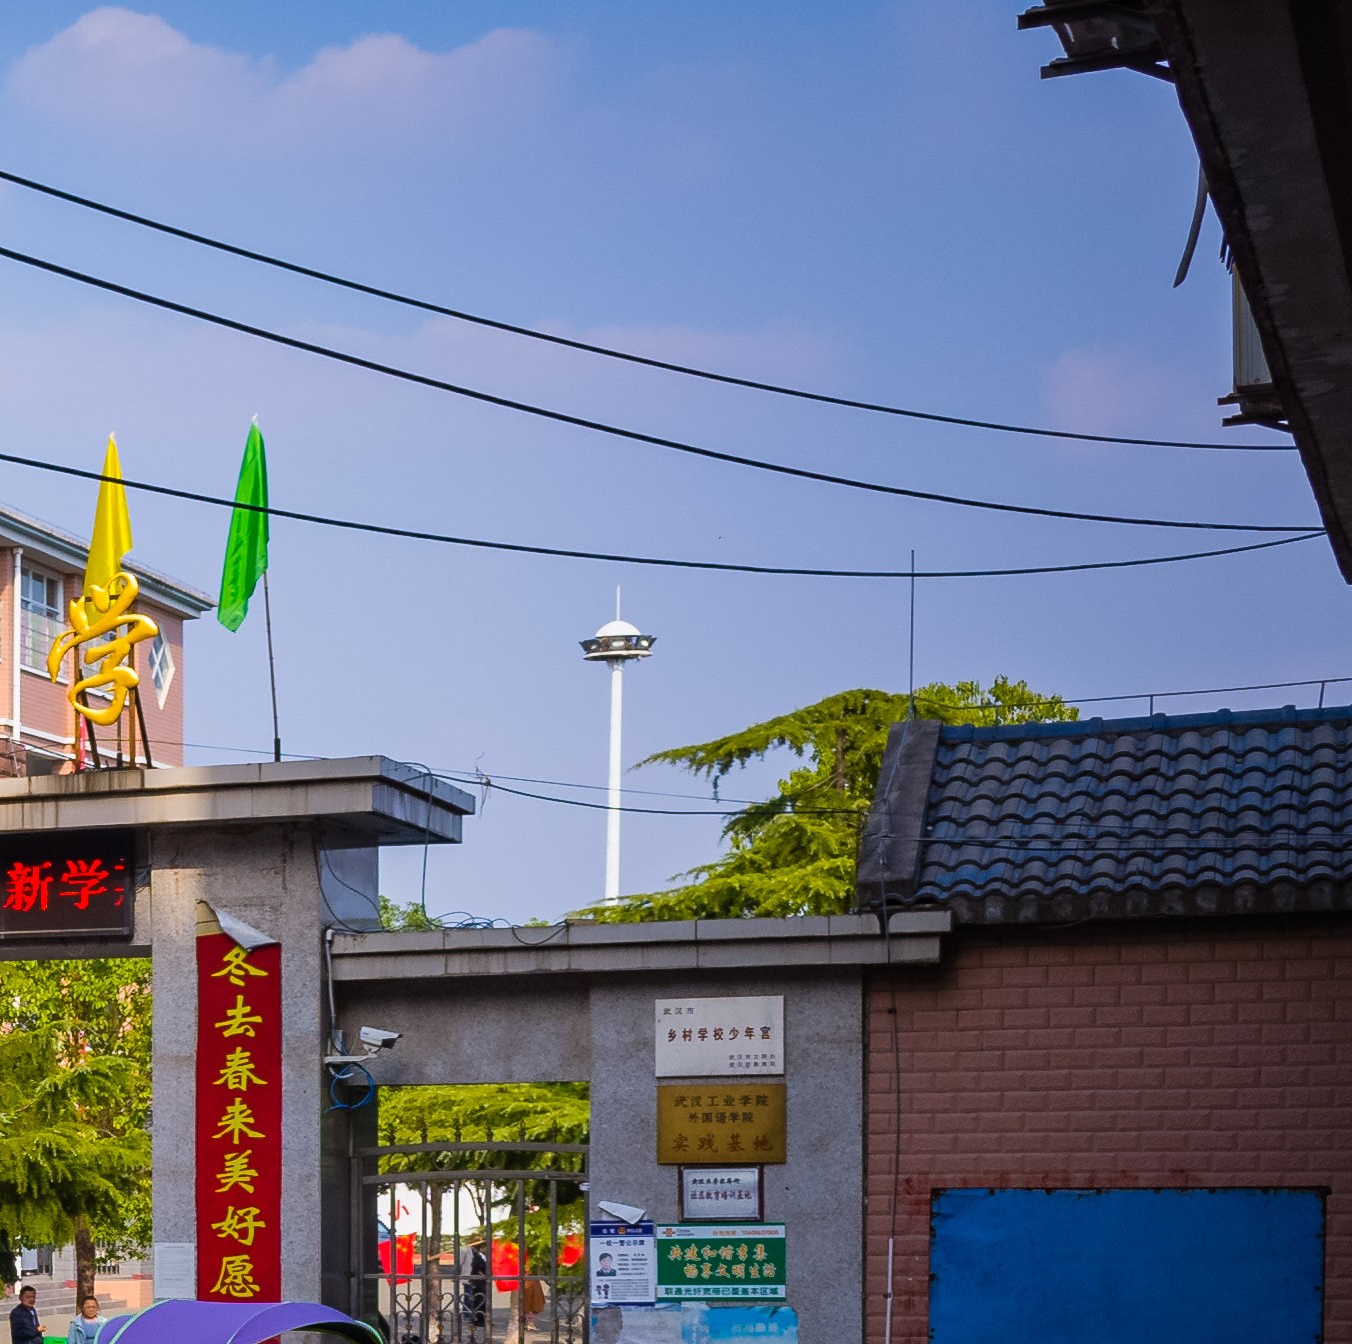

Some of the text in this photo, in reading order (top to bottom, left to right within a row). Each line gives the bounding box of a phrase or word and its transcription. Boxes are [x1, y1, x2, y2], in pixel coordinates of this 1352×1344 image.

[3, 858, 126, 913] 新学
[663, 1007, 695, 1016] 武汉市
[667, 1025, 772, 1042] 乡村学校少年宫
[673, 1094, 769, 1108] 武汉工业学院
[688, 1111, 754, 1124] 外国语学院
[671, 1132, 773, 1153] 实践基地
